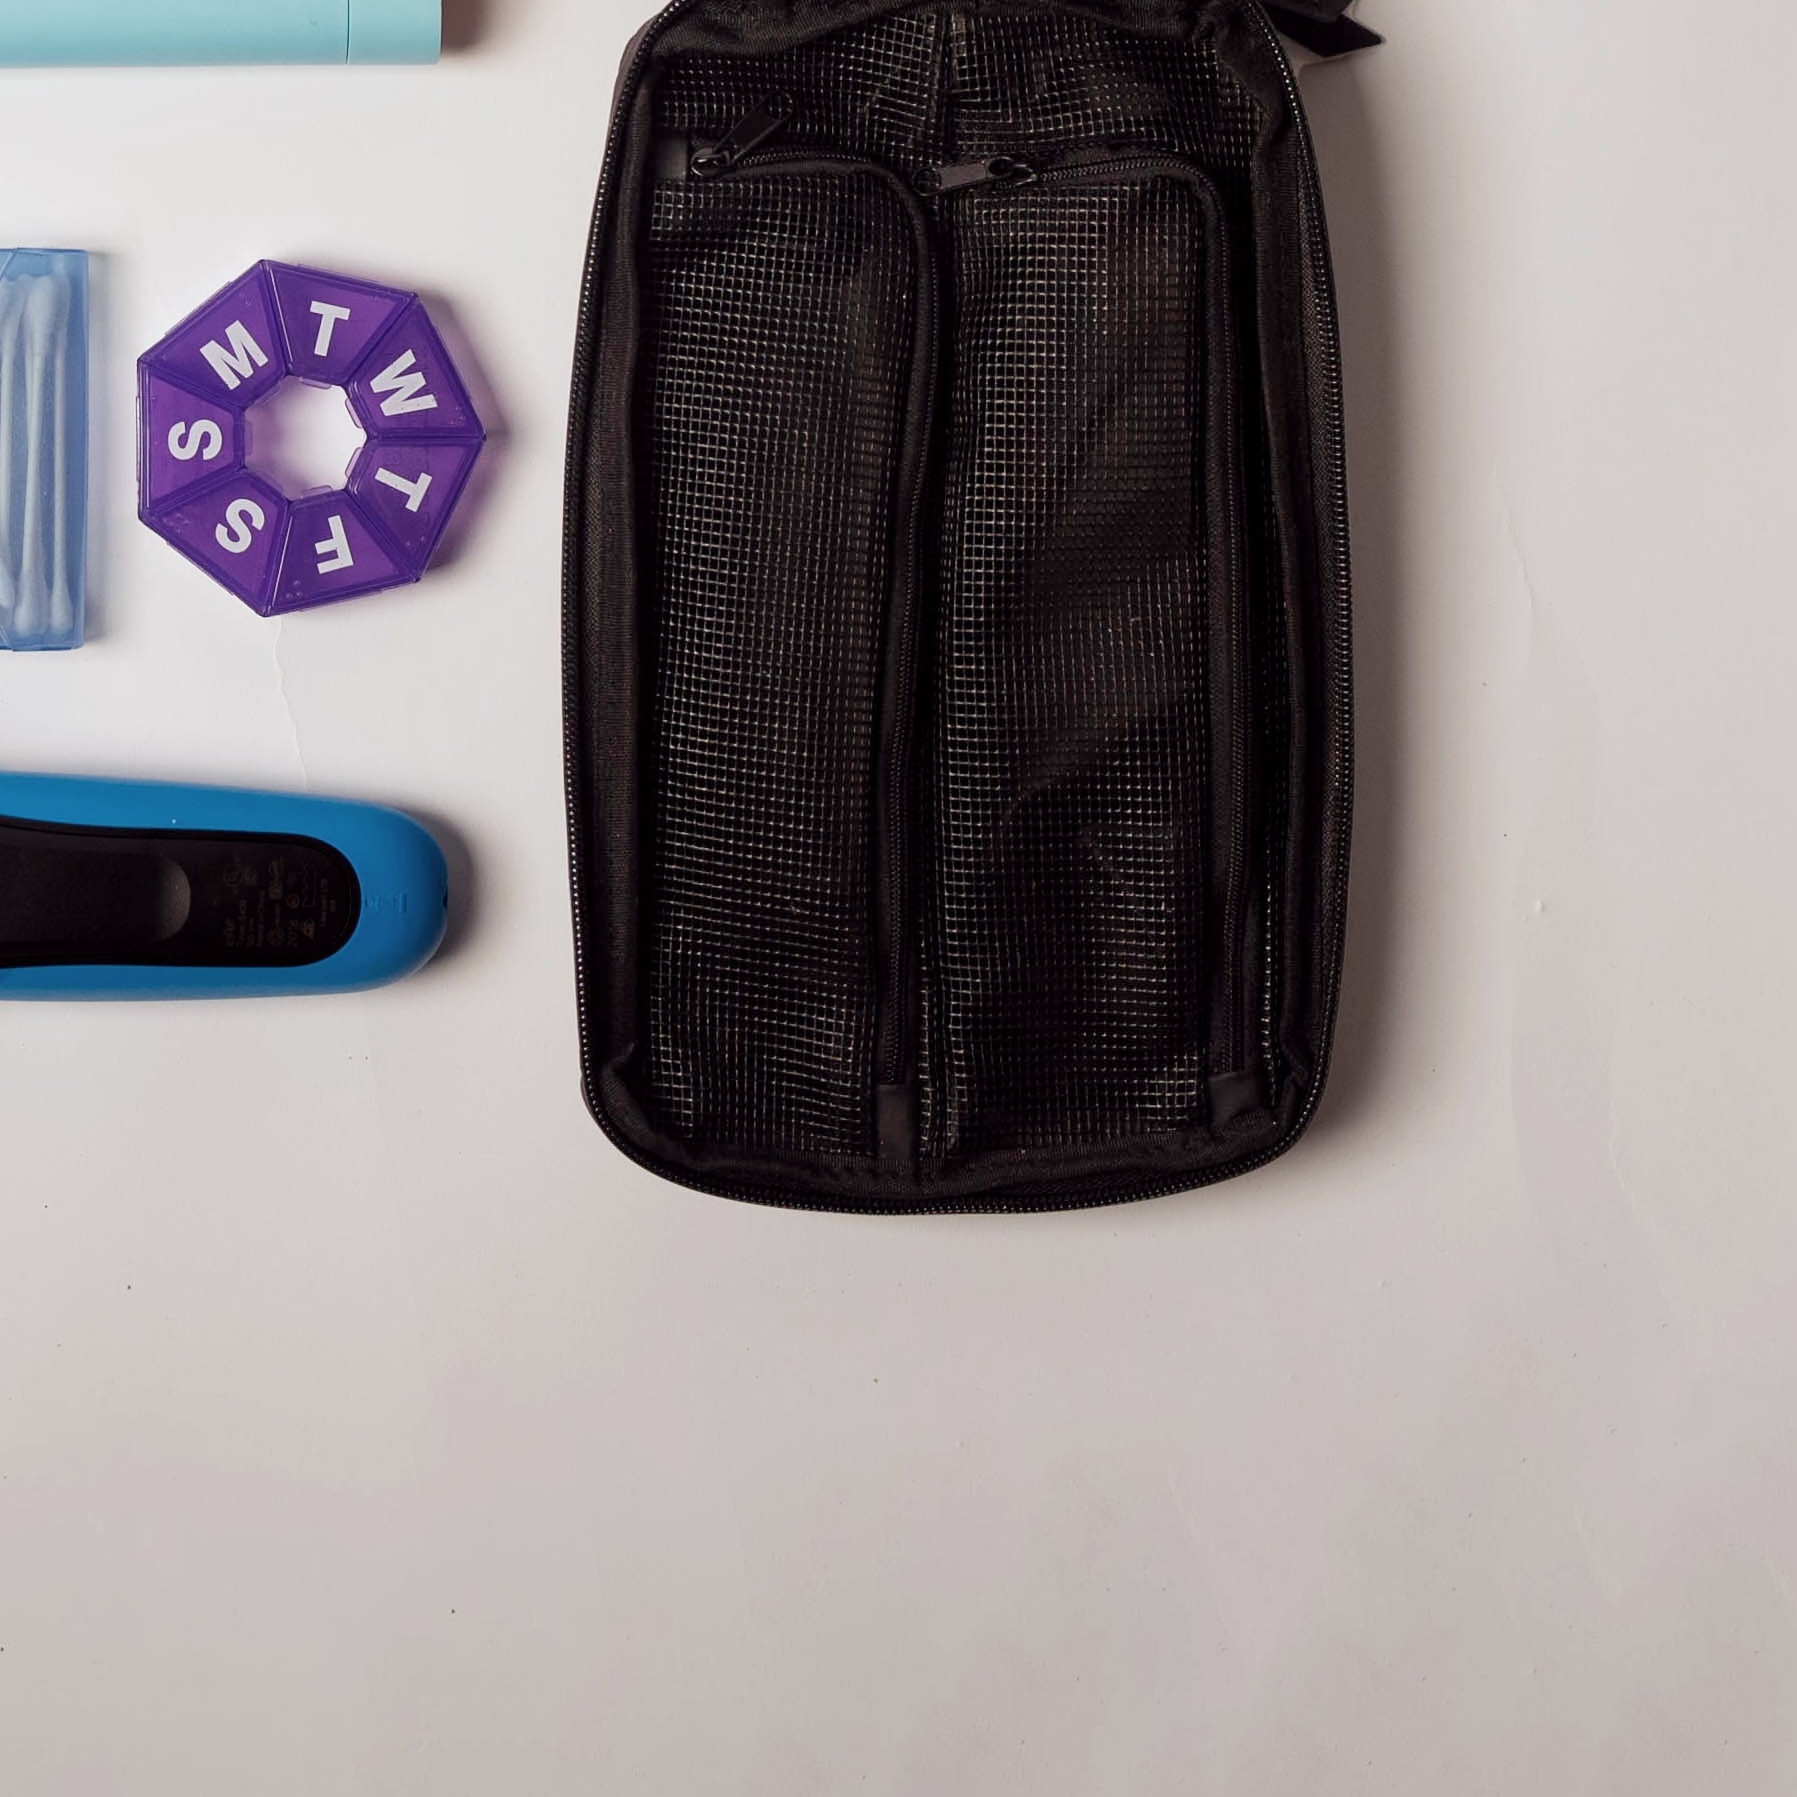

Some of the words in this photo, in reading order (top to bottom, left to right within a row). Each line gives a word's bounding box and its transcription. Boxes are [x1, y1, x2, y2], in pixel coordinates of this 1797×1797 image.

[199, 319, 268, 390] M
[309, 300, 351, 357] T
[369, 349, 438, 417] W
[167, 419, 223, 461] S
[374, 467, 432, 513] T
[215, 498, 266, 554] S
[314, 515, 355, 575] F
